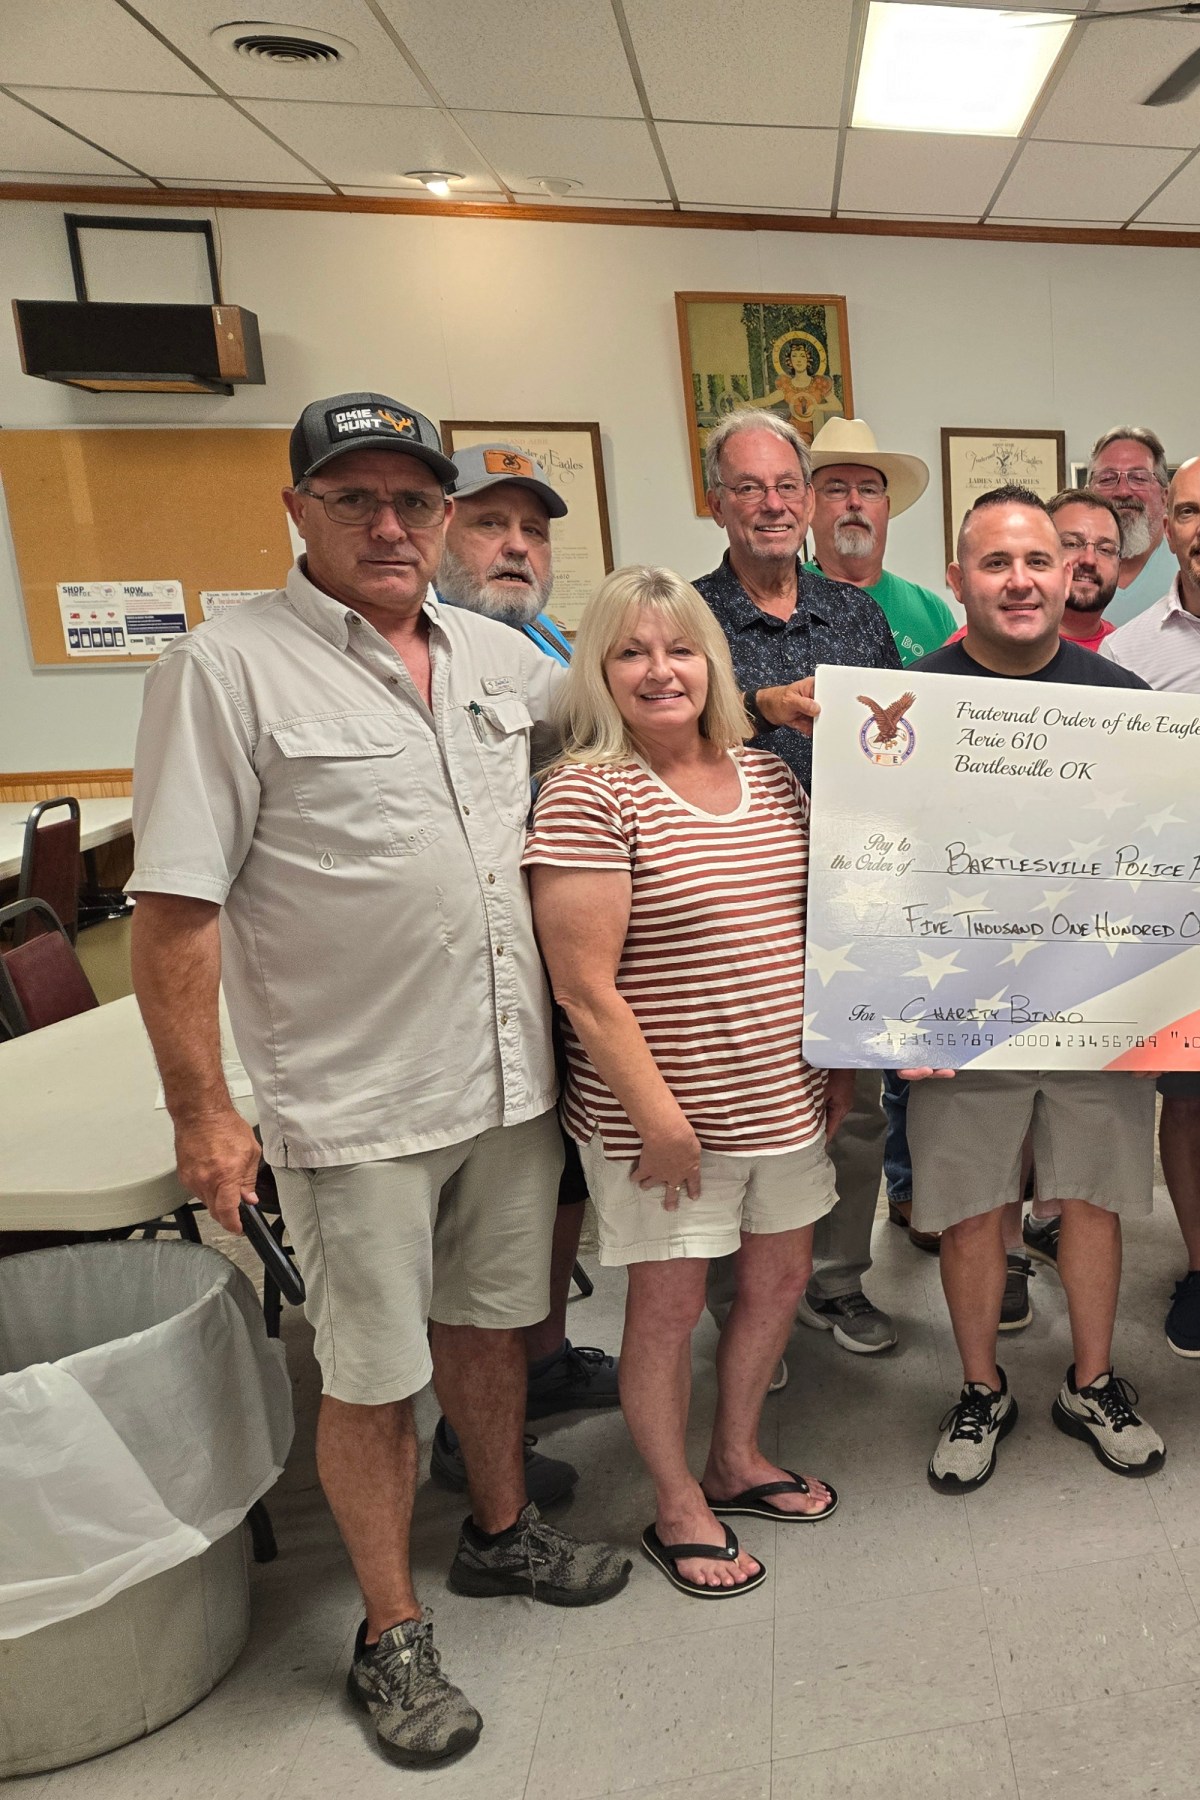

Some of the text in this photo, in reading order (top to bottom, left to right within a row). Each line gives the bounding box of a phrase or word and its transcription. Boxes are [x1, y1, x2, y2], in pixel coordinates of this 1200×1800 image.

[335, 408, 373, 424] OKIE
[337, 418, 382, 433] HUNT
[548, 449, 584, 481] Eagles
[62, 586, 85, 594] SHOP
[124, 586, 144, 594] HOW
[956, 701, 1037, 724] Fraternal
[1043, 706, 1096, 729] Order
[1101, 711, 1126, 736] of
[1126, 714, 1152, 733] the
[956, 728, 1048, 751] Aerie 610
[953, 754, 1098, 781] Bartlesville OK
[863, 833, 911, 856] Pay to
[830, 854, 916, 878] the Order of
[1051, 912, 1089, 936] ONE
[847, 1003, 876, 1022] For
